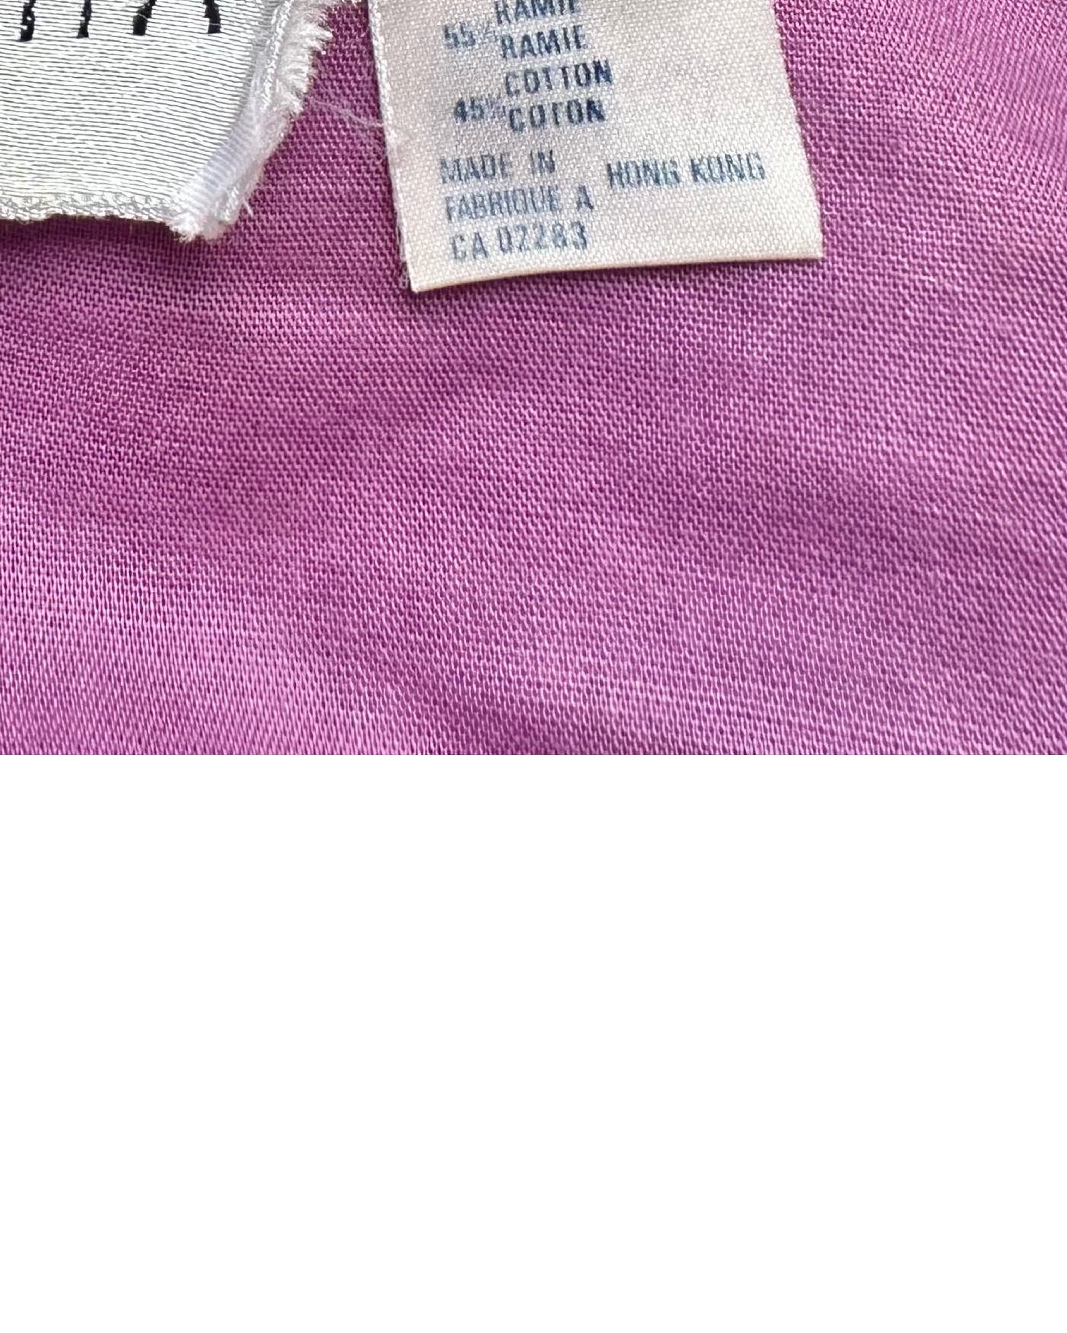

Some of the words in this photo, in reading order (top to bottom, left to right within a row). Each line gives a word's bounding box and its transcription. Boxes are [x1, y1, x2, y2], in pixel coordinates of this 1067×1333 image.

[500, 24, 589, 59] RAMIE
[504, 58, 613, 96] COTTON
[508, 97, 606, 132] COTON
[441, 153, 512, 184] MADE
[530, 149, 556, 175] IN
[607, 160, 682, 188] HONG
[690, 151, 766, 184] KONG
[446, 186, 561, 221] FABRIQUE
[576, 184, 595, 211] A
[451, 232, 489, 262] CA
